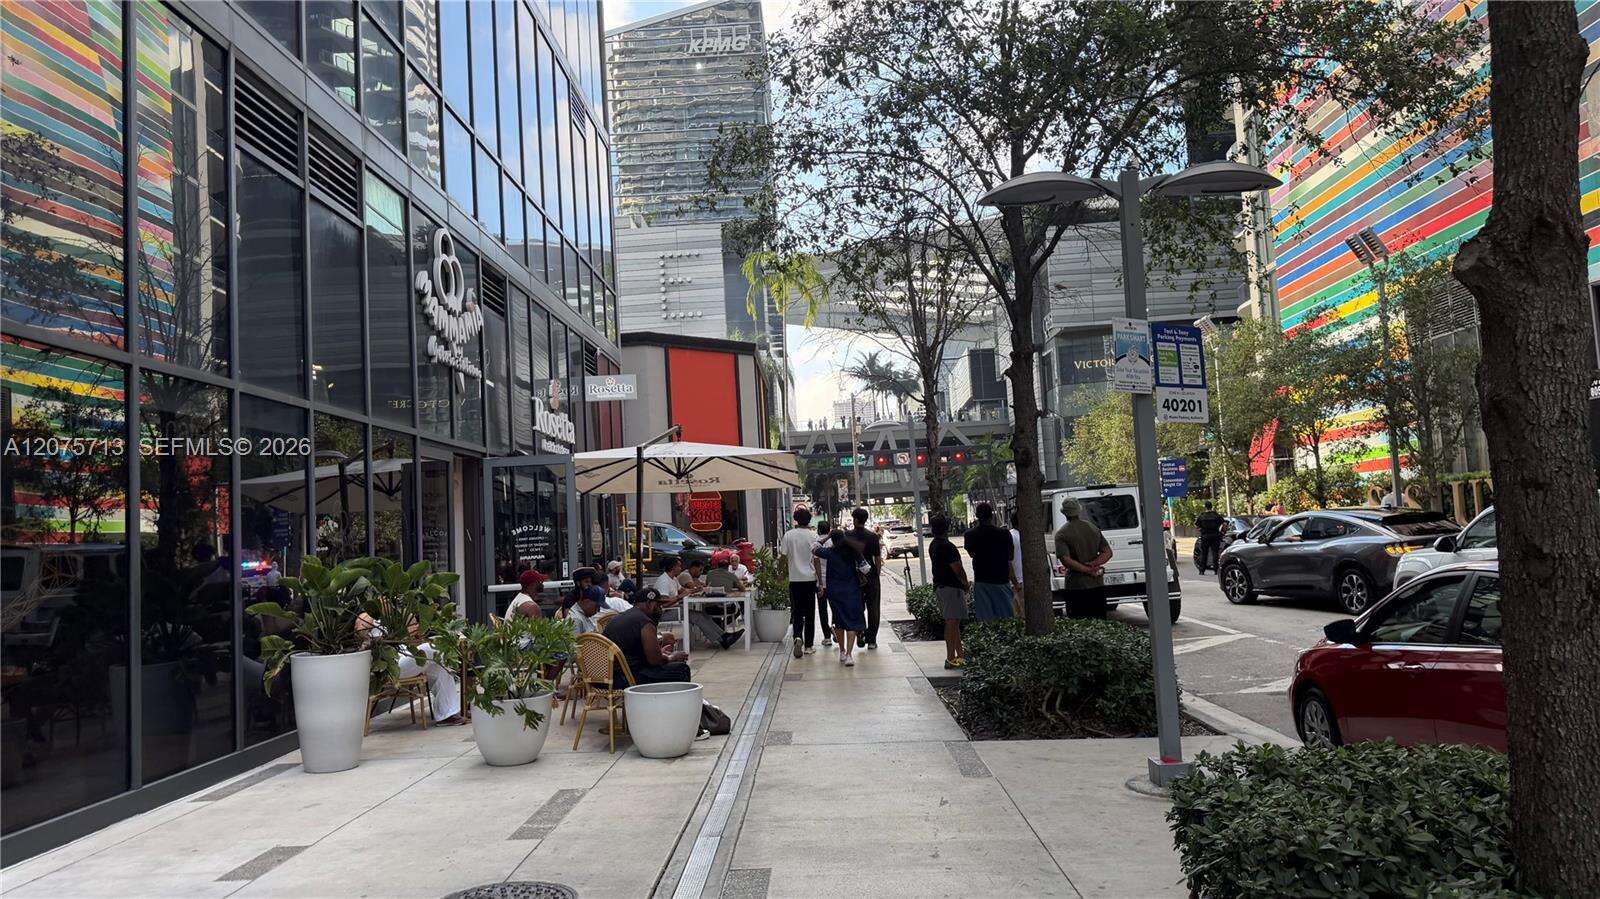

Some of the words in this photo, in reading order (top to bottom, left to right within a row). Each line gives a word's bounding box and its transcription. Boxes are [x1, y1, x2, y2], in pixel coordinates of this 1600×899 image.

[689, 35, 750, 53] KPMG
[1073, 359, 1115, 369] VICTOR
[589, 384, 633, 394] Rosetta
[1162, 398, 1202, 413] 40201
[531, 396, 576, 445] Rosetta
[691, 509, 721, 522] KING
